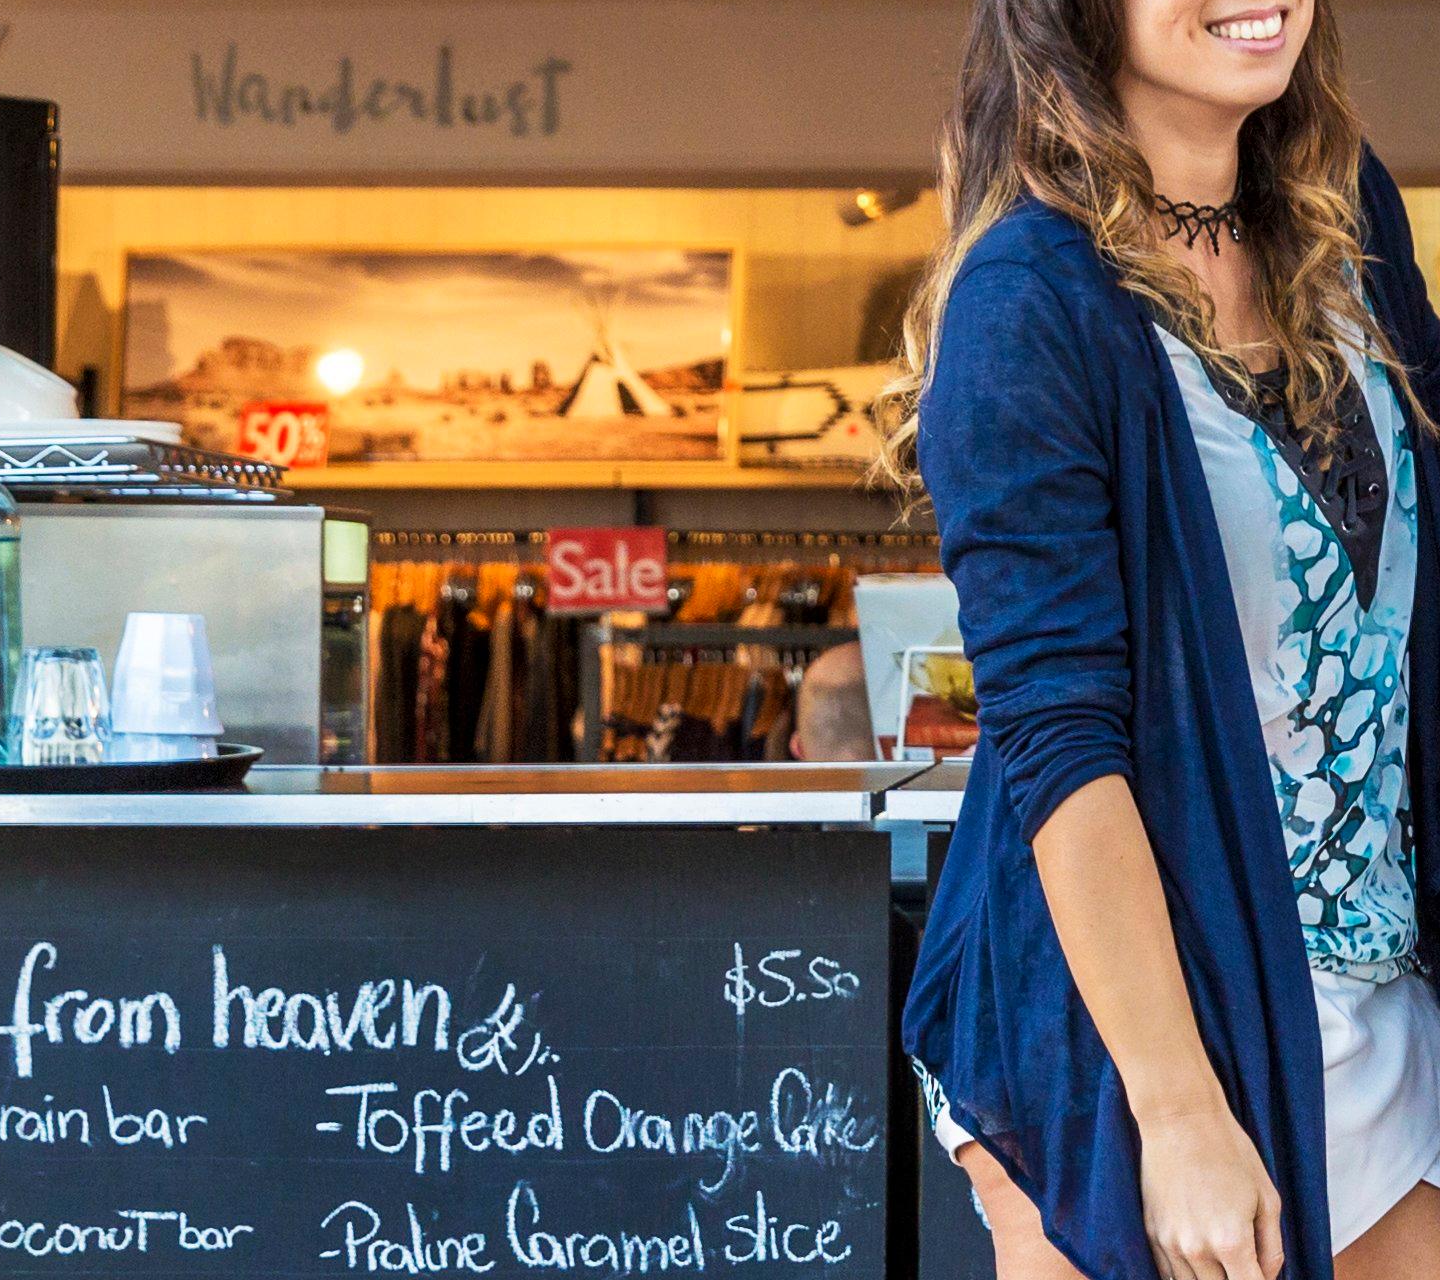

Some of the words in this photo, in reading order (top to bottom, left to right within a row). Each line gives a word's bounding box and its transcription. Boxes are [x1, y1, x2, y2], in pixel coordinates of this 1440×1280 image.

[191, 40, 574, 137] Wanderlust
[551, 538, 665, 599] Sale
[211, 942, 452, 1052] heaven
[724, 940, 860, 1016] $5.50
[101, 1083, 209, 1150] bar
[583, 1088, 763, 1196] Orange
[178, 1211, 254, 1253] bar
[506, 1179, 706, 1274] Caramel
